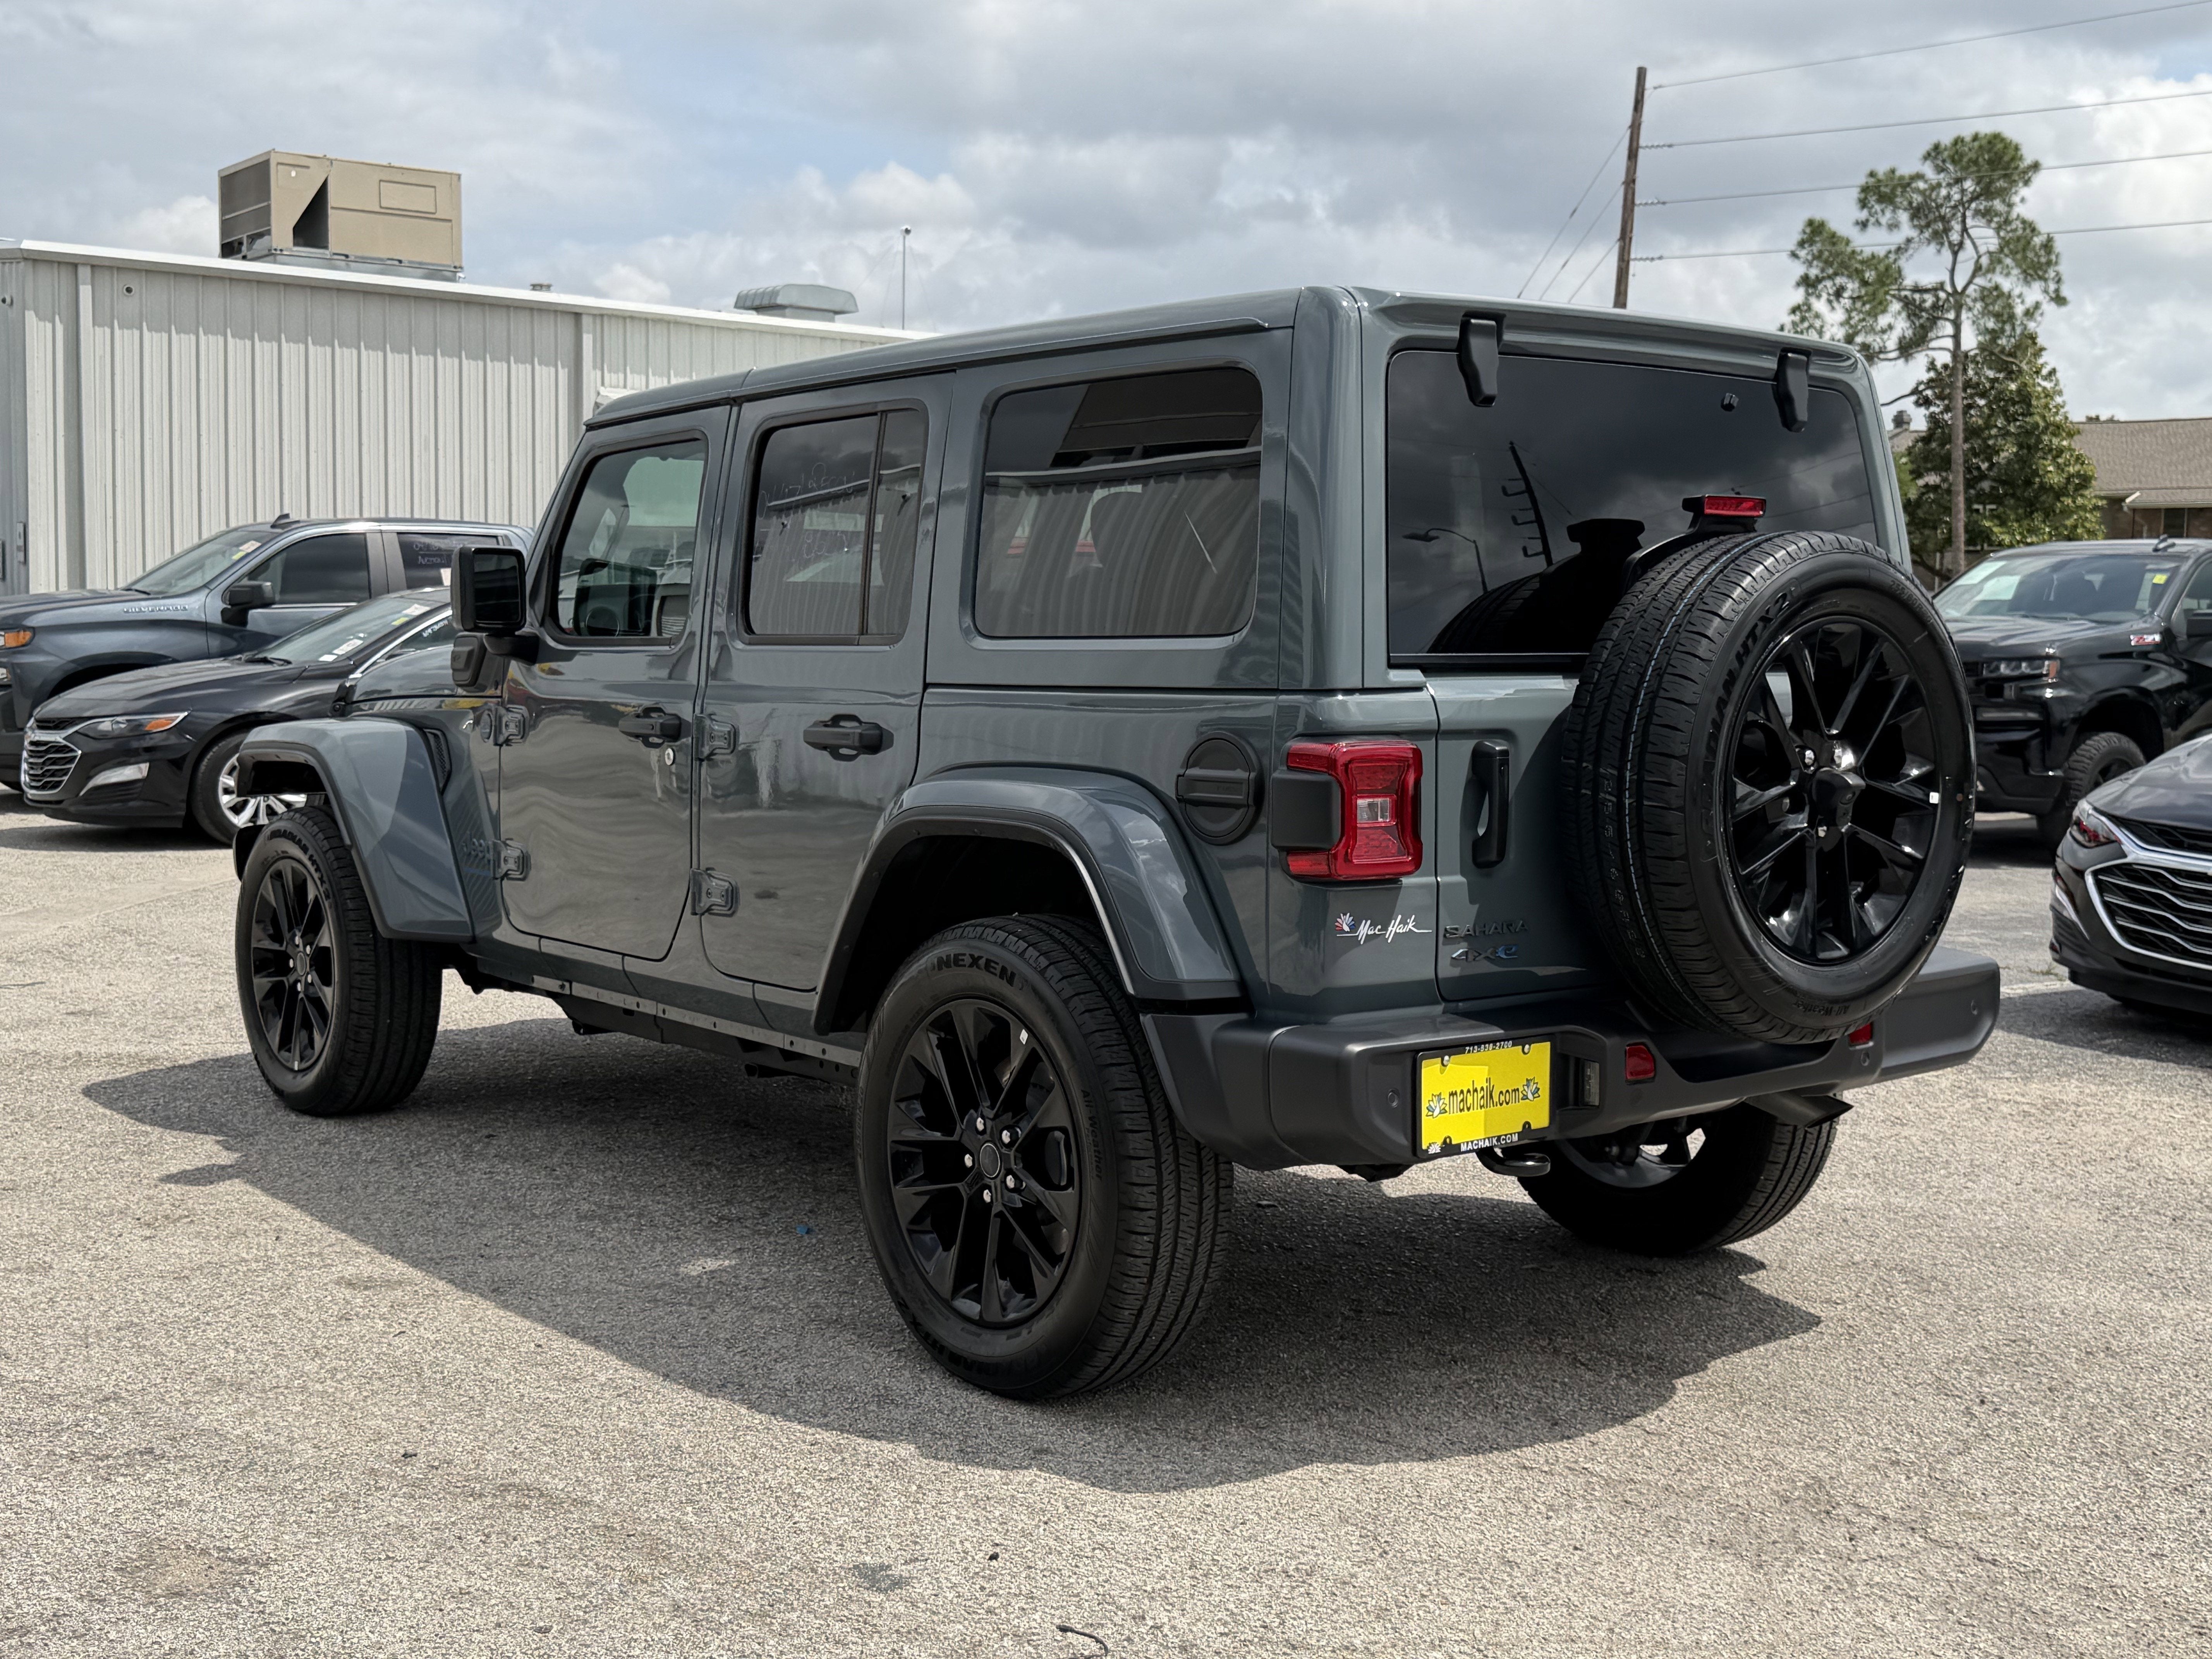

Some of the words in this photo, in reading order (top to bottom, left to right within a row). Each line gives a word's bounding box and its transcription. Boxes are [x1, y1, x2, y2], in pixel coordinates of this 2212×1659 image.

[1735, 592, 1790, 667] HTX2
[1337, 920, 1386, 945] Mac
[1385, 915, 1432, 943] Haik
[1444, 919, 1528, 938] SAHARA
[936, 953, 1017, 987] NEXEN
[1448, 1077, 1520, 1114] machaik.com
[1460, 1133, 1518, 1151] MACHAIK.COM
